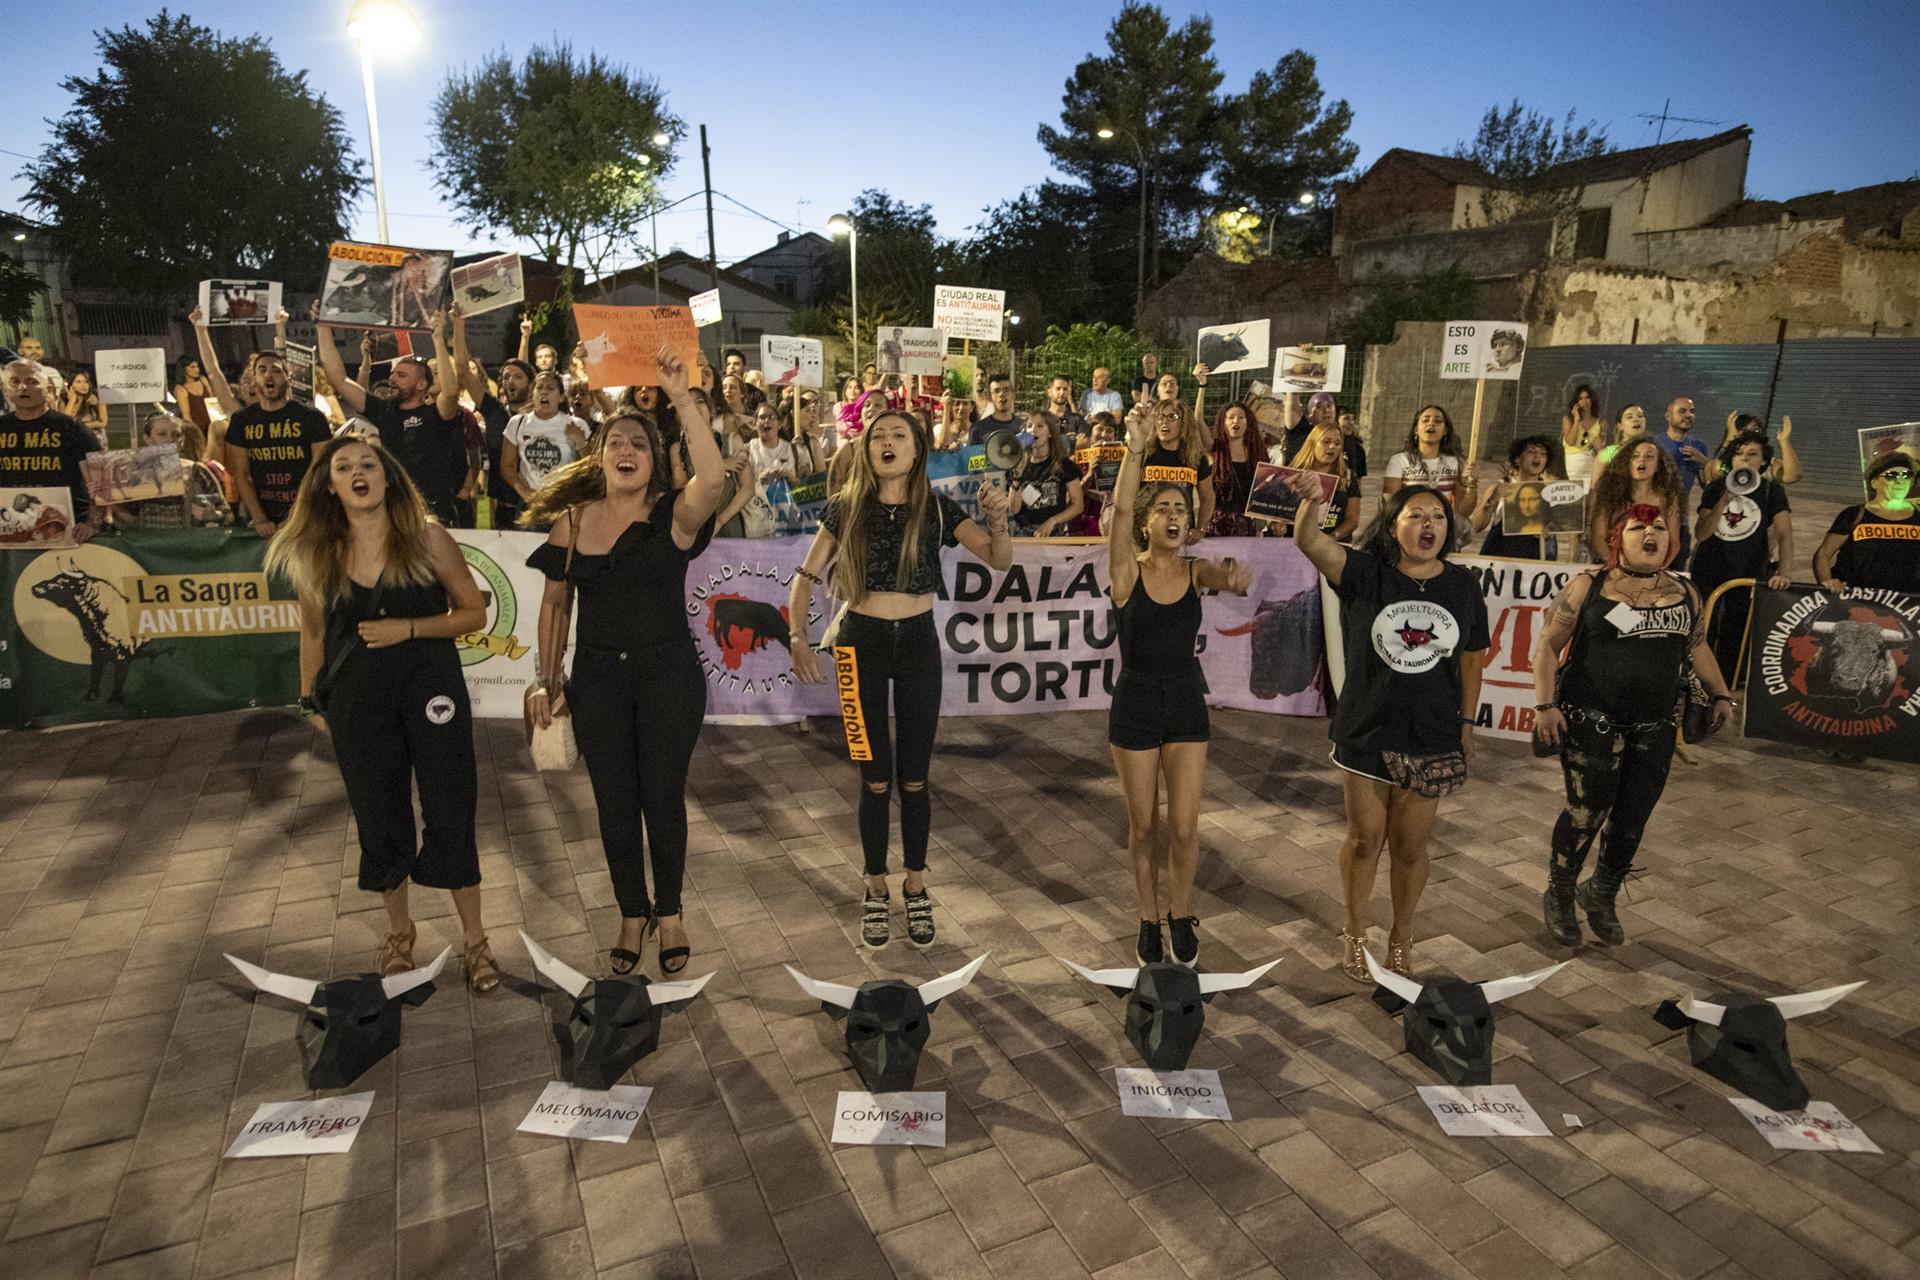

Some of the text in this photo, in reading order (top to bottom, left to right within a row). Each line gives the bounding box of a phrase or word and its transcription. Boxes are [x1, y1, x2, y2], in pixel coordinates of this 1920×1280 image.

[941, 289, 999, 303] CIUDAD REAL
[936, 299, 1002, 311] ES ANTITAURINA
[938, 315, 952, 324] NO
[1448, 326, 1476, 338] ESTO
[1454, 344, 1468, 355] ES
[1444, 362, 1471, 373] ARTE
[245, 419, 301, 440] NO MÁS
[25, 428, 61, 449] MÁS
[137, 578, 259, 606] La Sagra
[1762, 586, 1919, 696] COORDINADORA CASTILLA
[464, 674, 526, 688] @gmail.com
[837, 649, 865, 745] ABOLICIÓN
[1782, 700, 1897, 737] ANTITAURINA
[1132, 1085, 1212, 1097] INICIADO
[1438, 1102, 1518, 1115] DELATOR
[841, 1110, 944, 1122] COMISARIO
[249, 1116, 361, 1135] TRAMPERO
